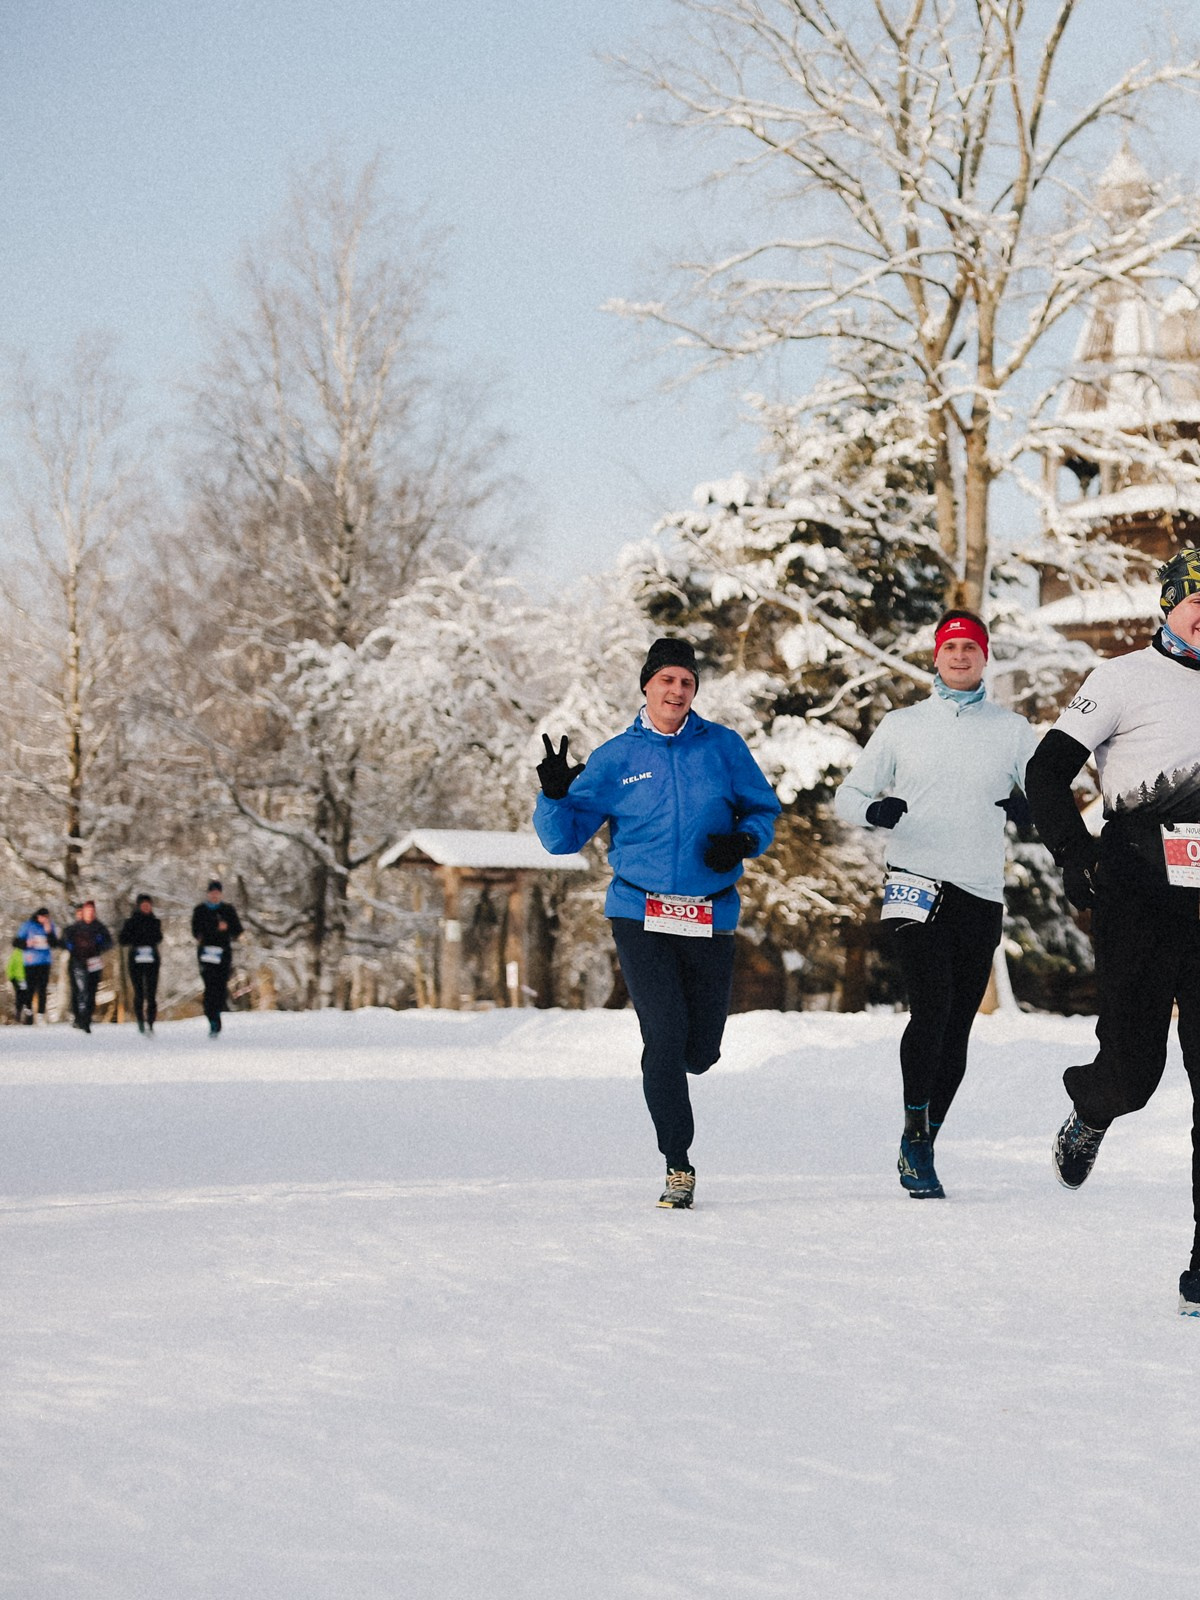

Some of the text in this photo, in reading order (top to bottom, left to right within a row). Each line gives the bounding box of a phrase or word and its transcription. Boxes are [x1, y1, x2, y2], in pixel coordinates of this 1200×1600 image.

[622, 771, 653, 785] KELME
[889, 884, 921, 902] 336
[661, 903, 699, 919] 090
